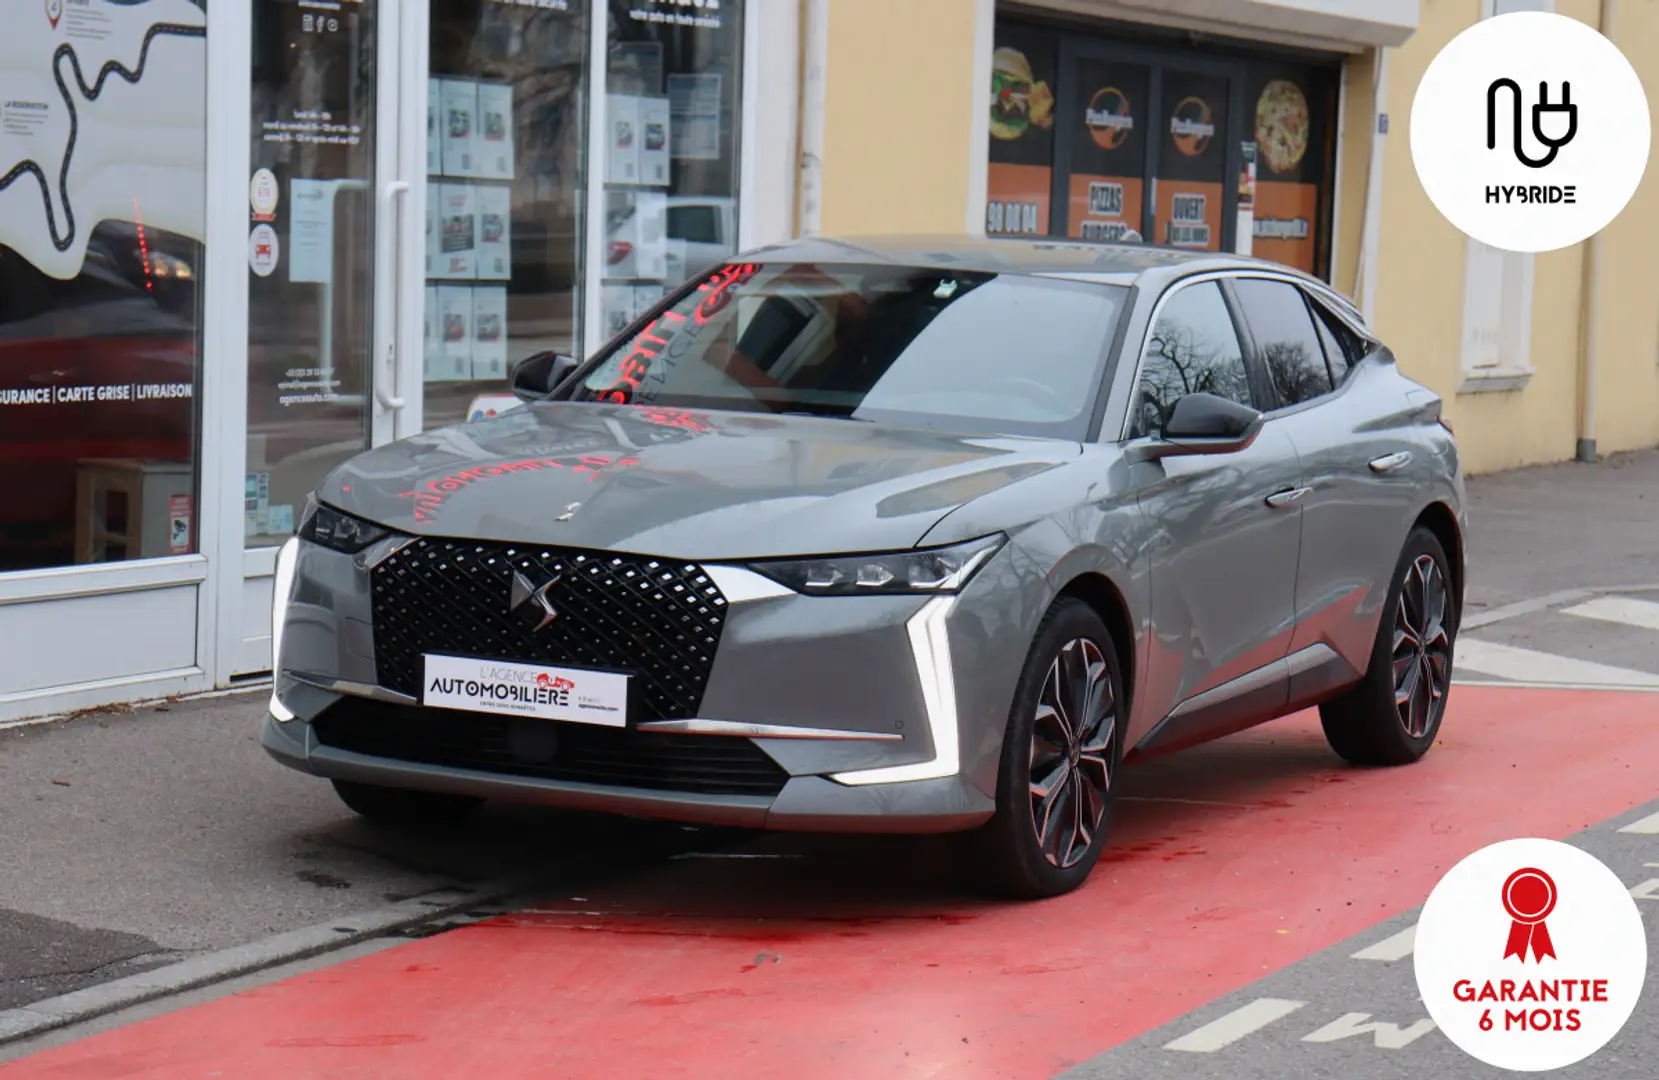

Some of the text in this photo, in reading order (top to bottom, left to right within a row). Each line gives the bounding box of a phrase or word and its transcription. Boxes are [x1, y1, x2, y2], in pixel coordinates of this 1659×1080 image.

[1089, 185, 1122, 213] PIZZAS
[57, 386, 96, 402] CARTE
[96, 385, 130, 400] GRISE
[137, 384, 193, 399] LIVRAISON
[480, 667, 538, 684] L'AGENCE
[430, 678, 569, 706] AUTOMOBILIERE
